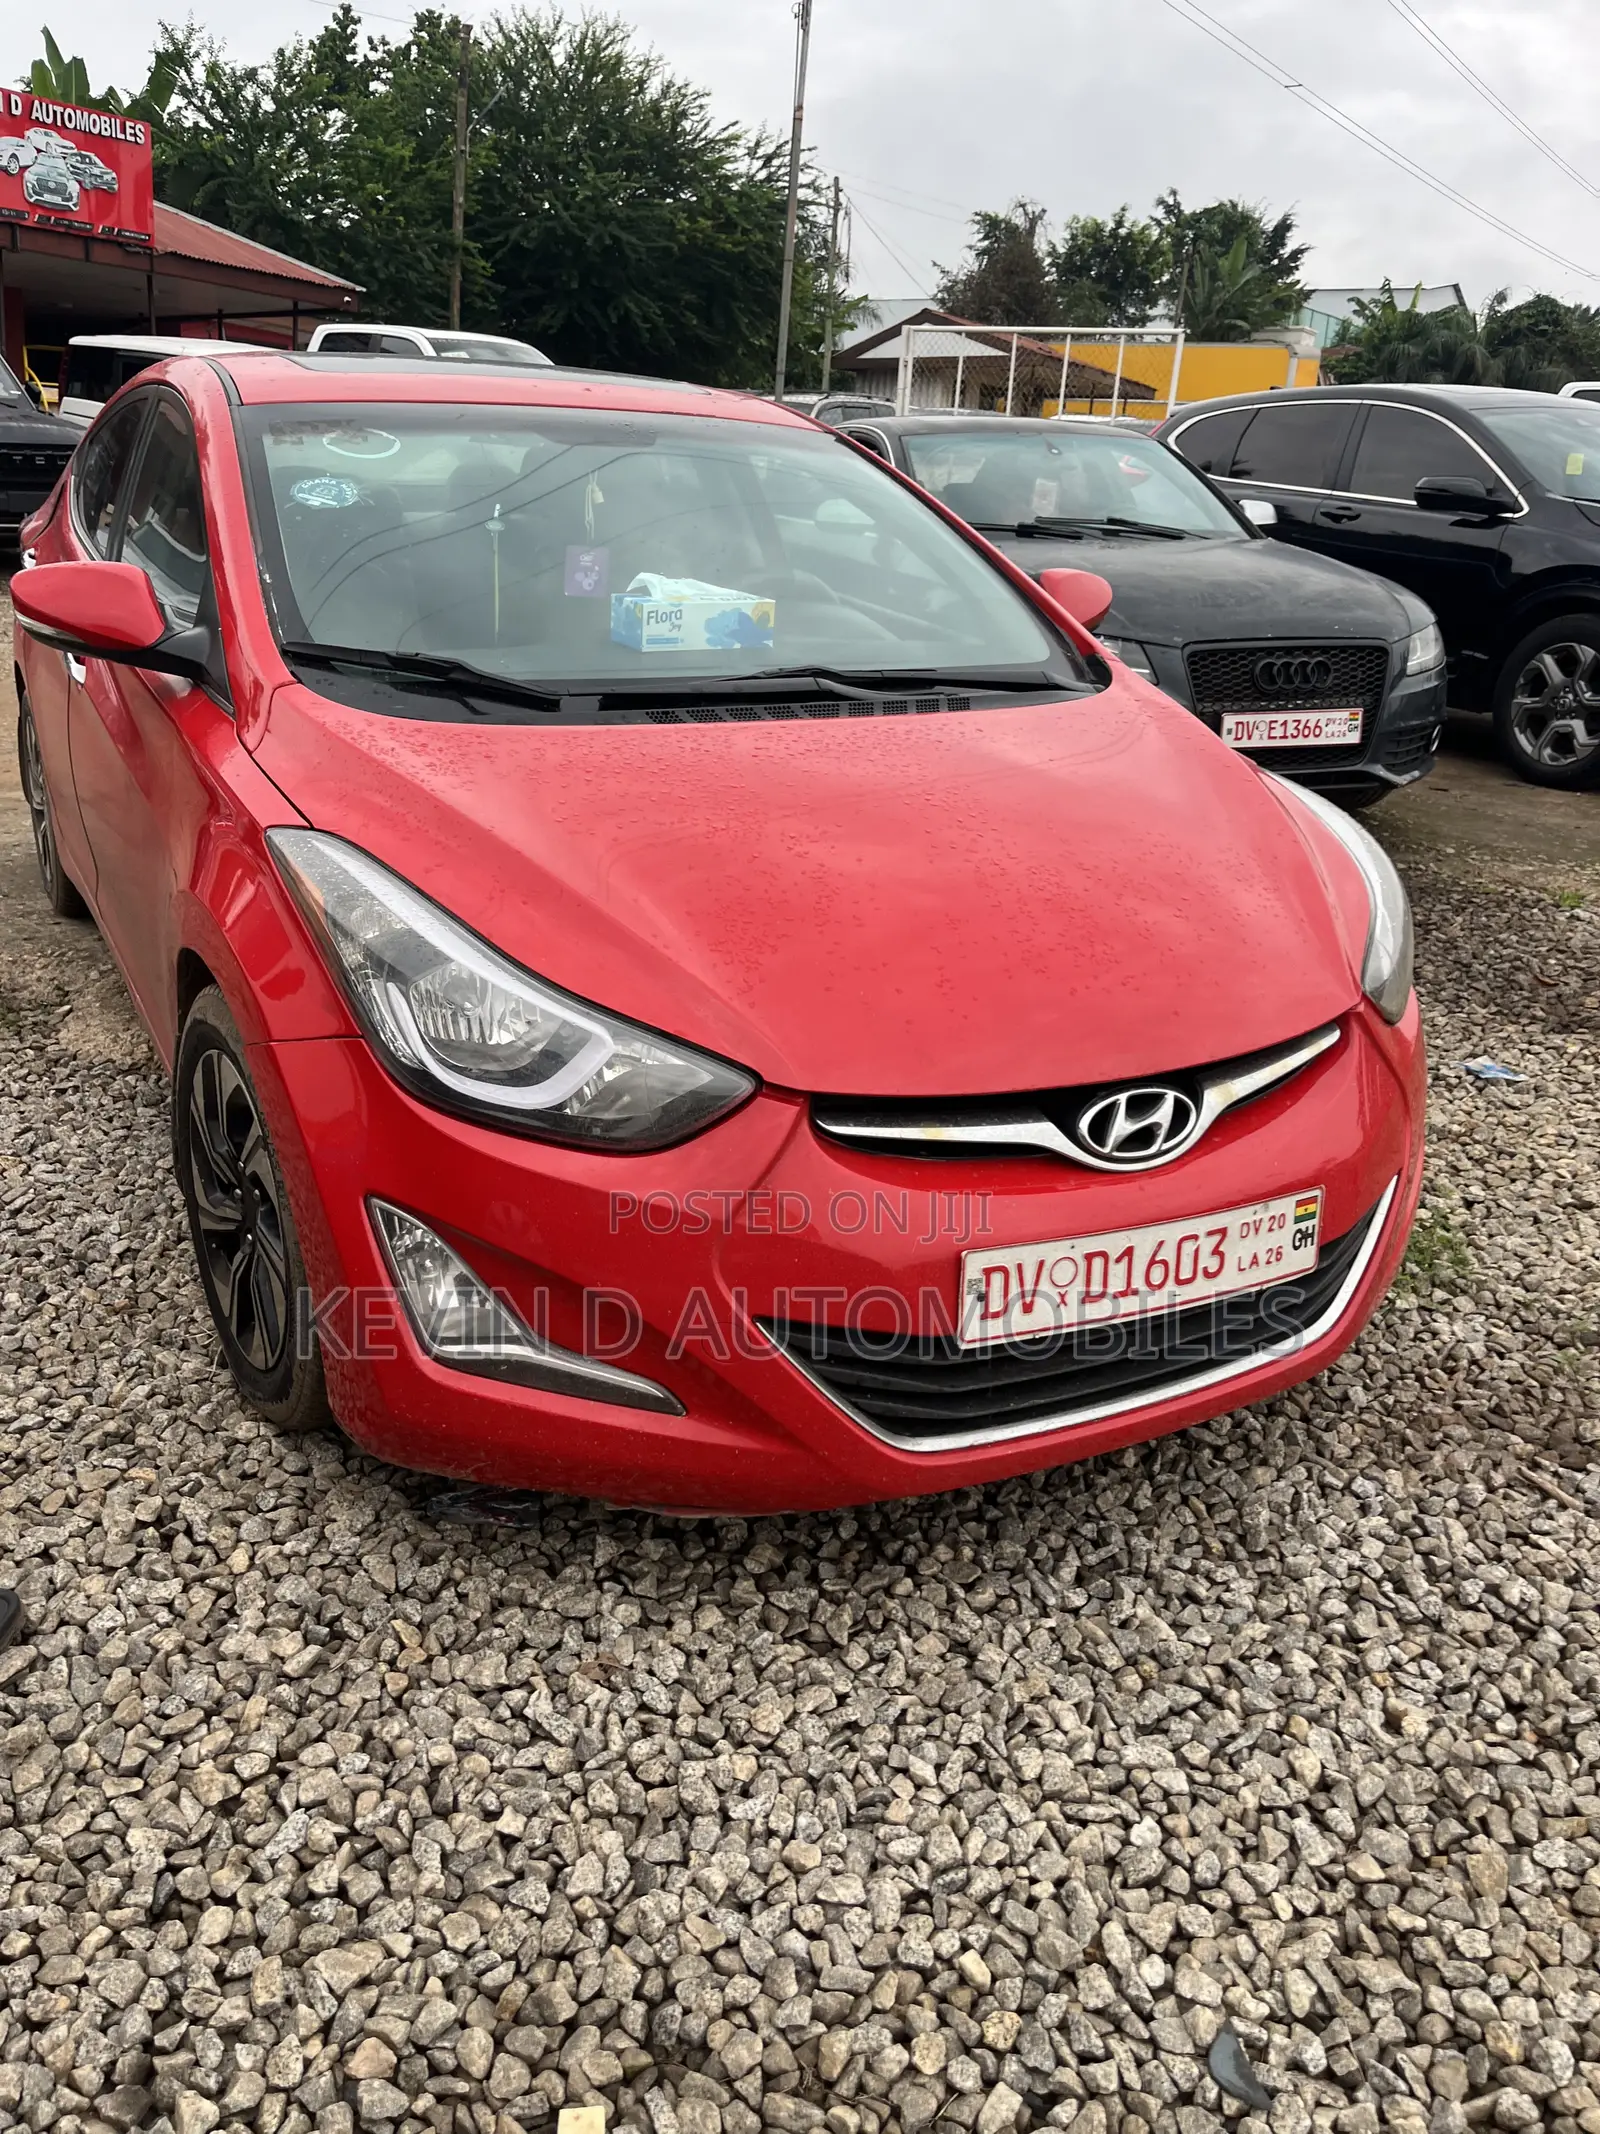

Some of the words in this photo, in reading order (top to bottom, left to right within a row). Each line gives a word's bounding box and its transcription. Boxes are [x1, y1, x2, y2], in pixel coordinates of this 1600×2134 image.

[10, 93, 23, 116] D
[31, 99, 146, 144] AUTOMOBILES
[646, 608, 683, 626] Flora
[668, 621, 682, 632] Joy
[1233, 720, 1257, 741] DV
[1267, 718, 1323, 740] E1366
[1347, 723, 1359, 733] GH
[1240, 1217, 1263, 1239] DV
[1267, 1212, 1286, 1233] 20
[1292, 1224, 1317, 1251] GH
[1238, 1252, 1260, 1272] LA
[1265, 1245, 1284, 1265] 26
[980, 1259, 1045, 1321] DV
[1081, 1226, 1229, 1305] D1603
